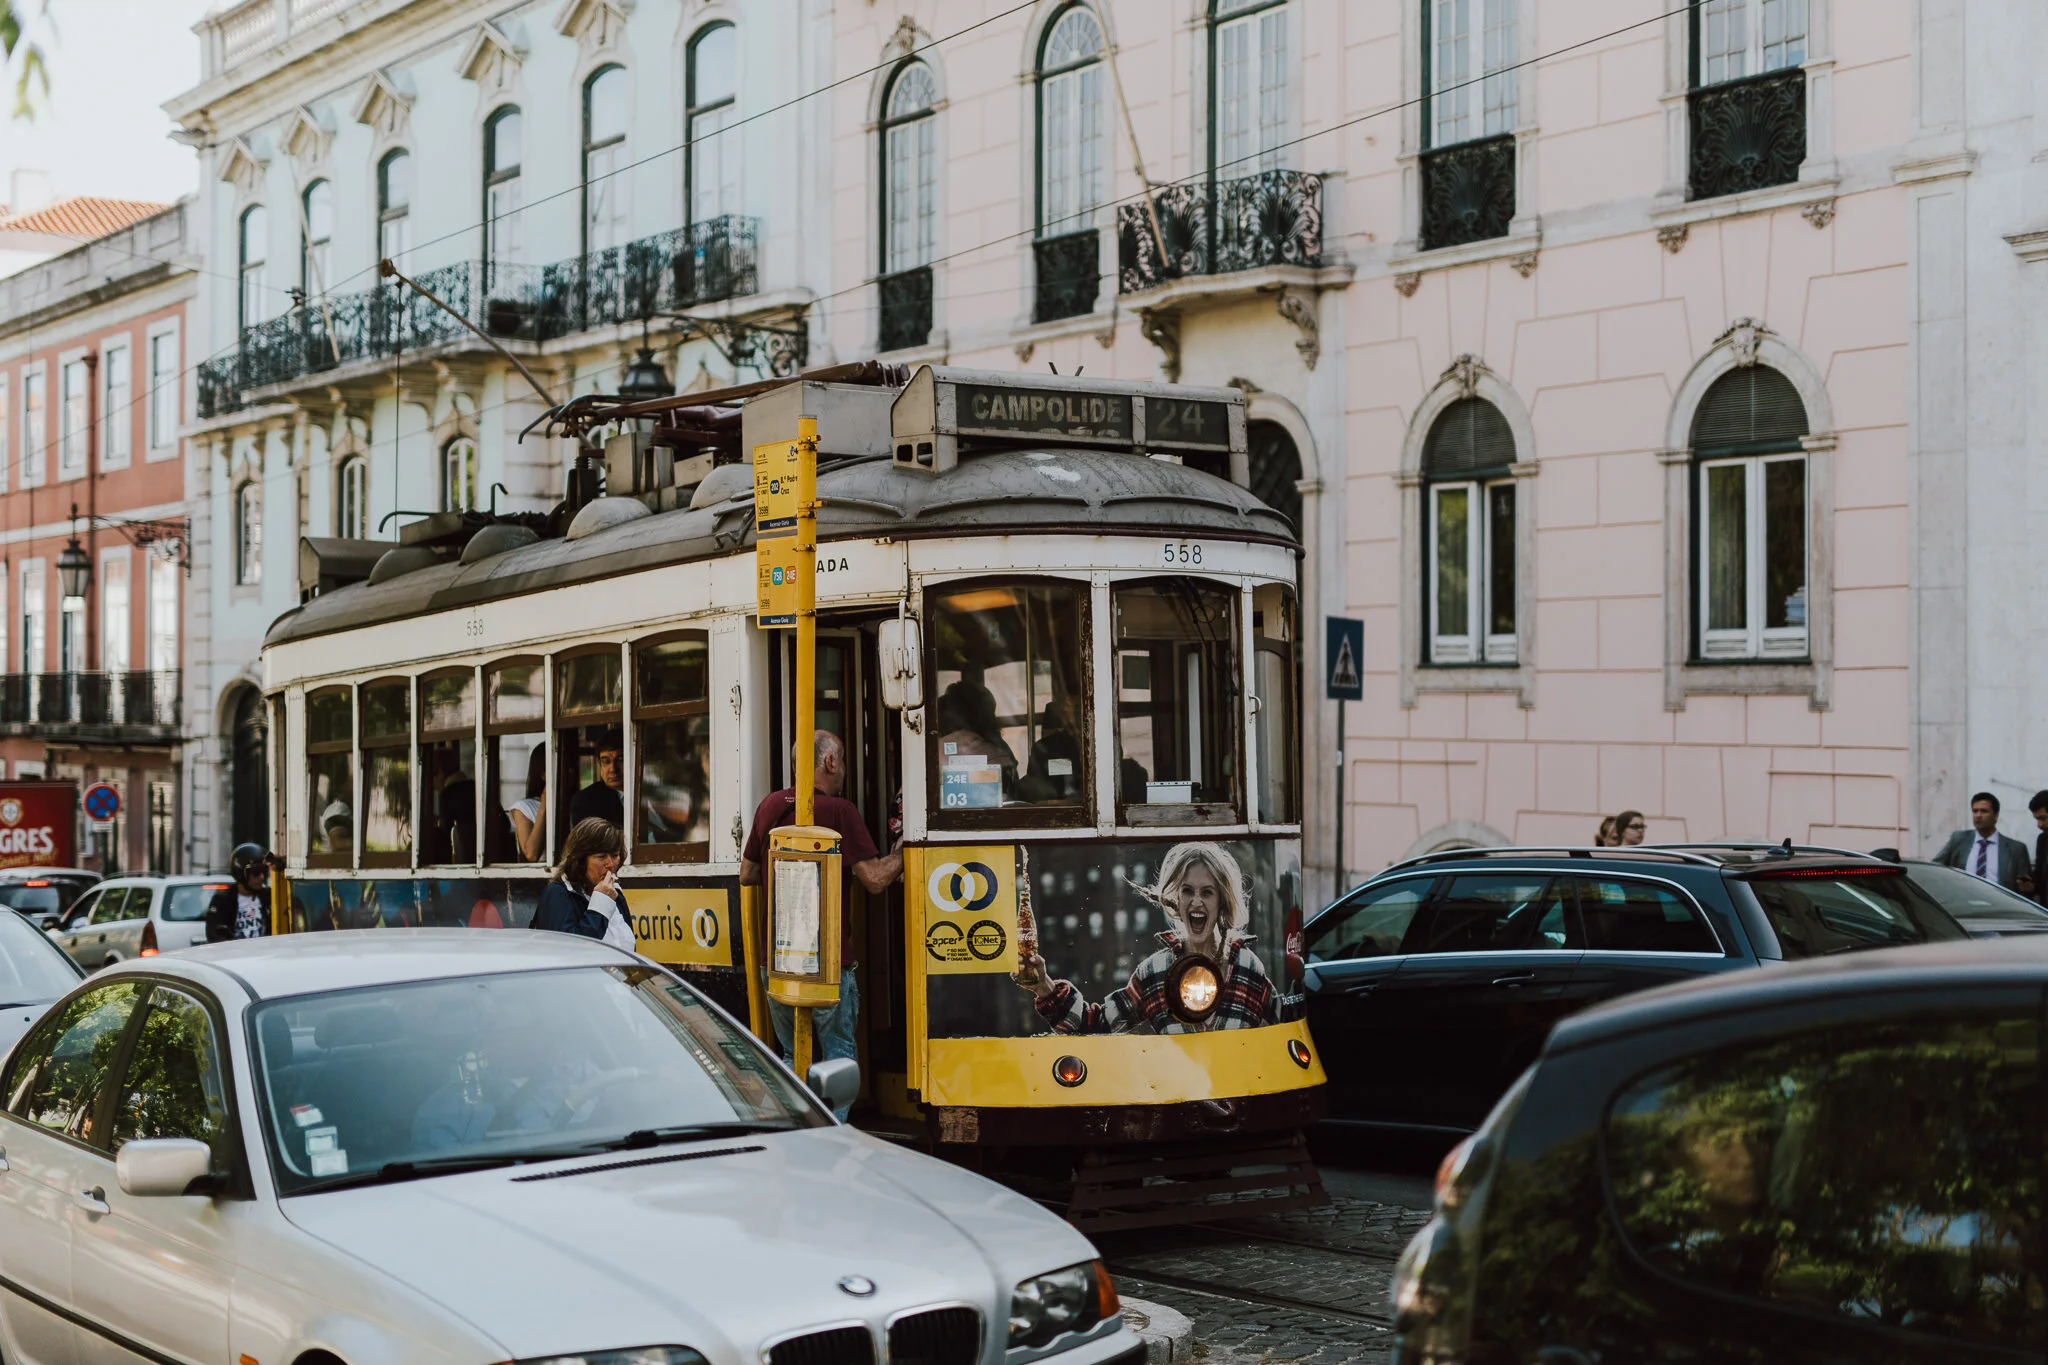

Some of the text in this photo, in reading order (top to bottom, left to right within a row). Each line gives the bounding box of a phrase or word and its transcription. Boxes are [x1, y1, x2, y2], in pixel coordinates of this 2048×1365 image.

[971, 393, 1122, 424] CAMPOLIDE
[1155, 401, 1204, 436] 24
[1164, 543, 1202, 565] 558
[816, 558, 849, 574] ADA
[466, 618, 484, 637] 558
[946, 774, 967, 784] 24E
[947, 792, 968, 807] 03
[0, 826, 54, 854] GRES
